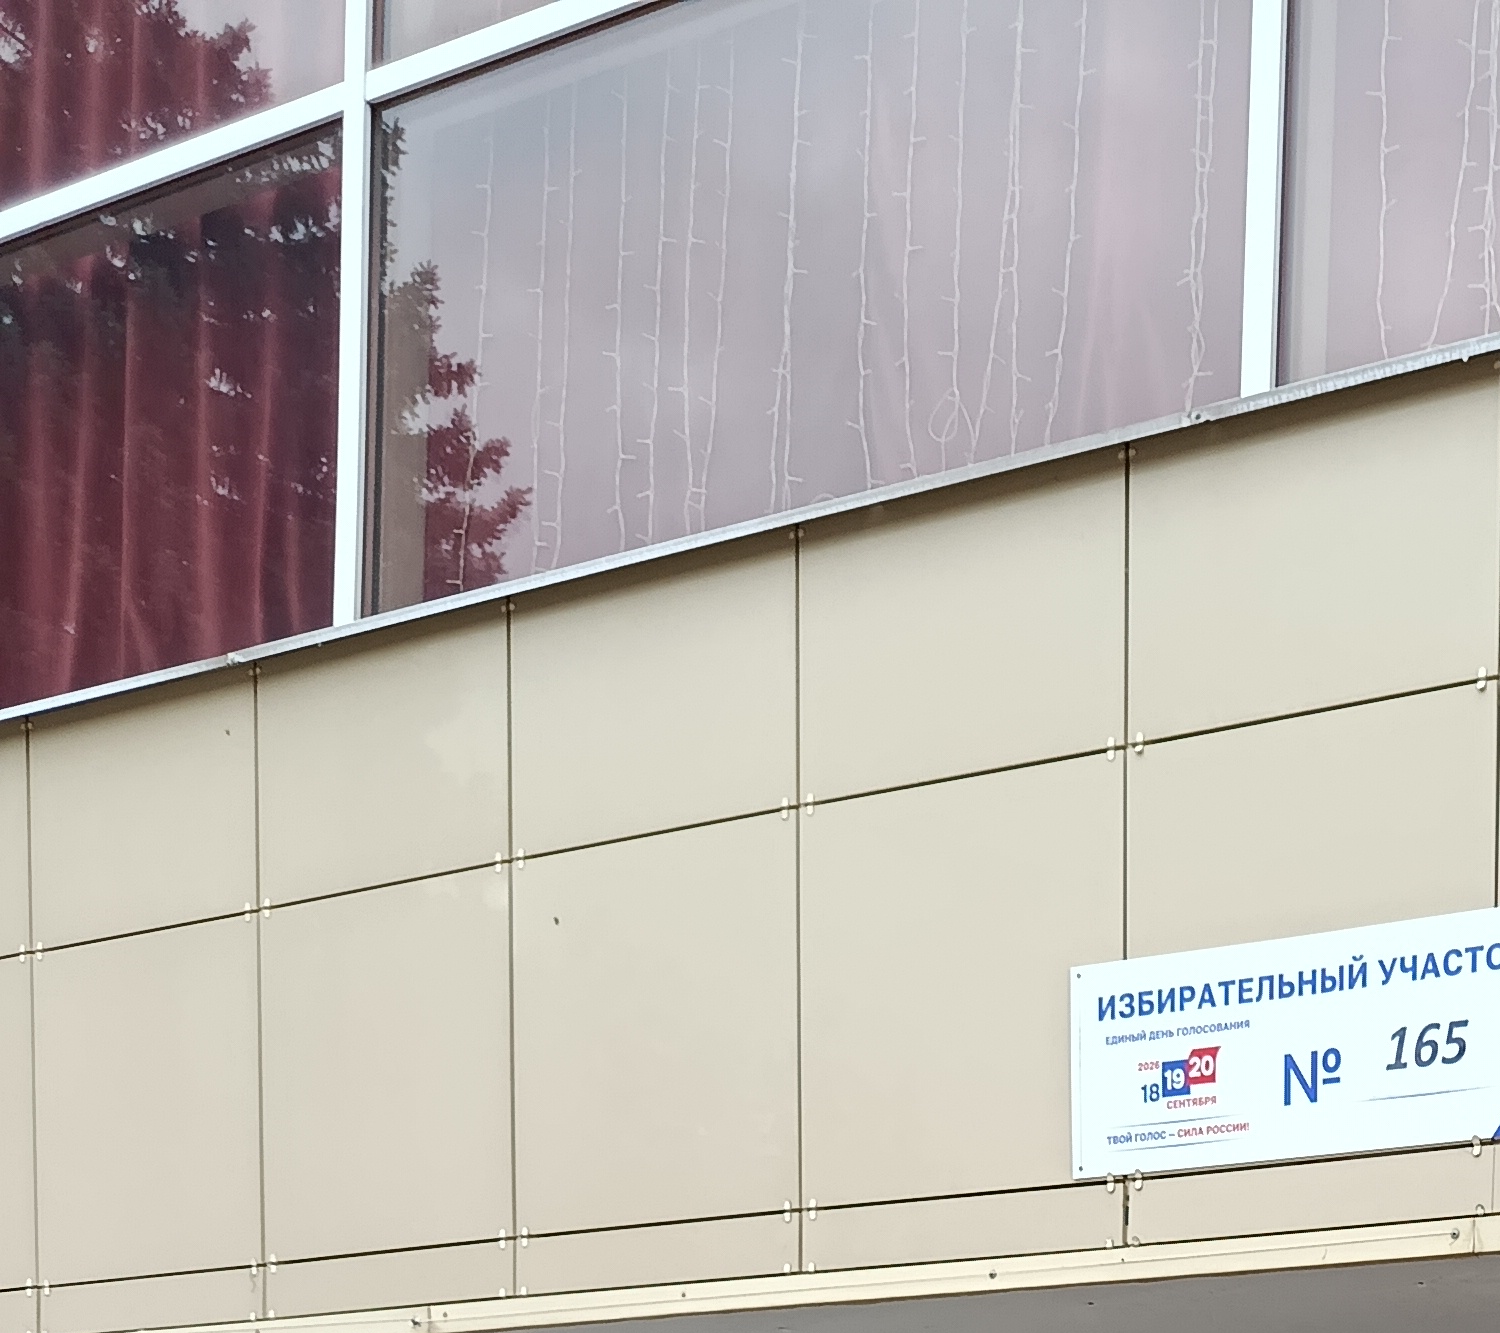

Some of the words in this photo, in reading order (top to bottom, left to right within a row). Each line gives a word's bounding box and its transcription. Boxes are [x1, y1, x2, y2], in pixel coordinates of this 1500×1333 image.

[1098, 955, 1368, 1022] ИЗБИРАТЕЛЬНЫЙ
[1105, 1029, 1147, 1046] ЕДИНЫЙ
[1148, 1029, 1175, 1042] ДЕНЬ
[1176, 1019, 1251, 1037] ГОЛОСОВАНИЯ
[1140, 1082, 1161, 1104] 18
[1163, 1067, 1186, 1091] 19
[1188, 1054, 1215, 1079] 20
[1283, 1046, 1342, 1106] №
[1386, 1019, 1470, 1072] 165
[1166, 1095, 1217, 1110] СЕНТЯБРЯ
[1106, 1131, 1133, 1146] ТВОЙ
[1134, 1130, 1167, 1143] ГОЛОС
[1177, 1126, 1204, 1139] СИЛА
[1206, 1122, 1250, 1136] РОССИИ!
